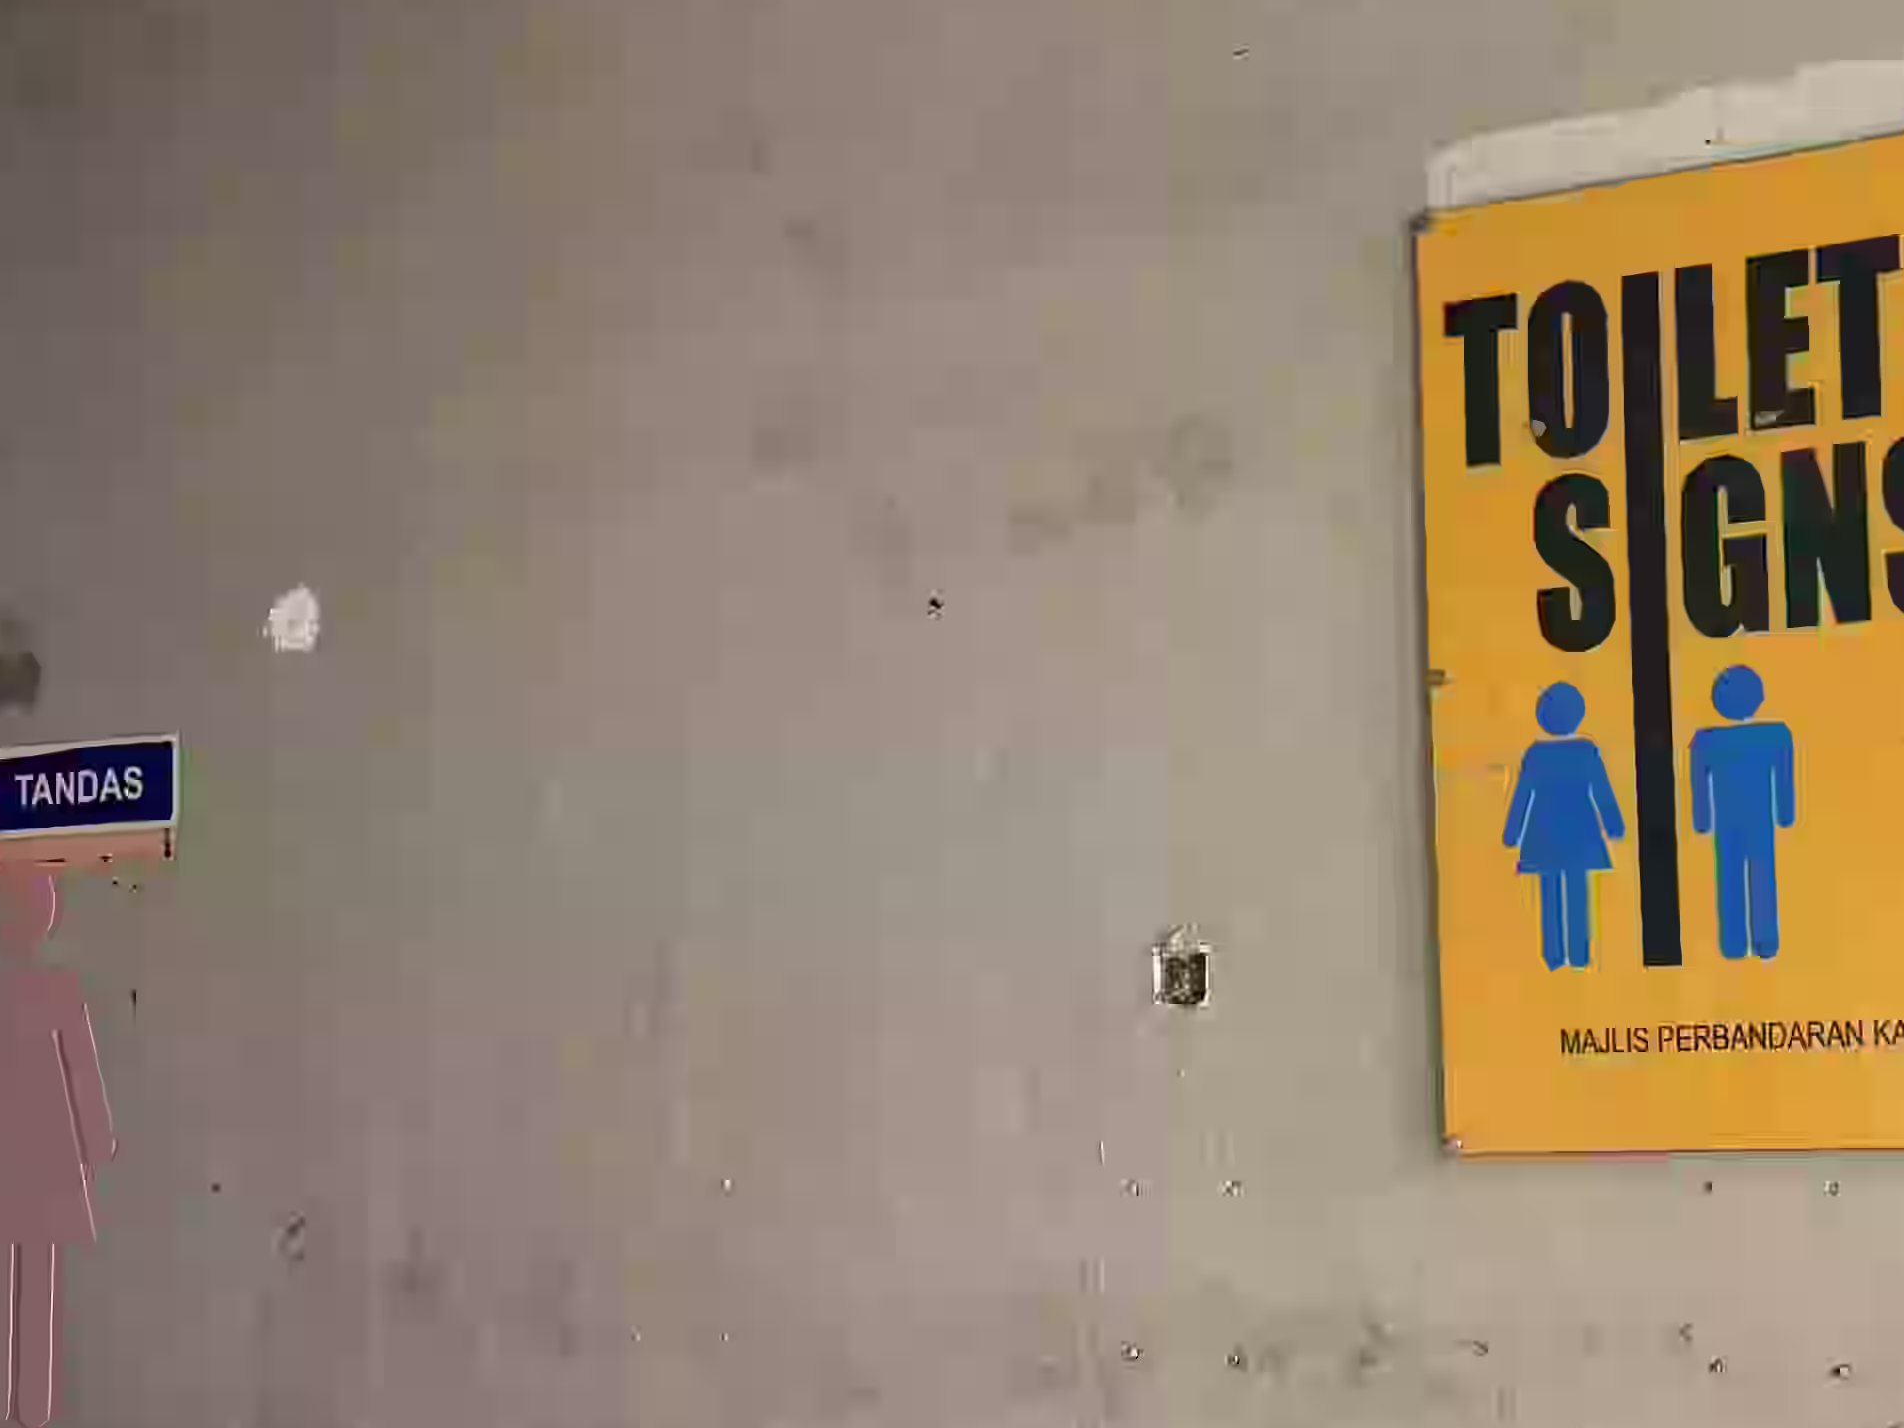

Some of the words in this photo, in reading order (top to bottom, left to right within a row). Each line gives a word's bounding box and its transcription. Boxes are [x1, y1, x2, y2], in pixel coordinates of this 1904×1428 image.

[1443, 233, 1901, 467] TOILET
[14, 765, 144, 807] TANDAS
[1559, 1026, 1650, 1055] MAJLIS
[1657, 1020, 1864, 1054] PERBANDARAN
